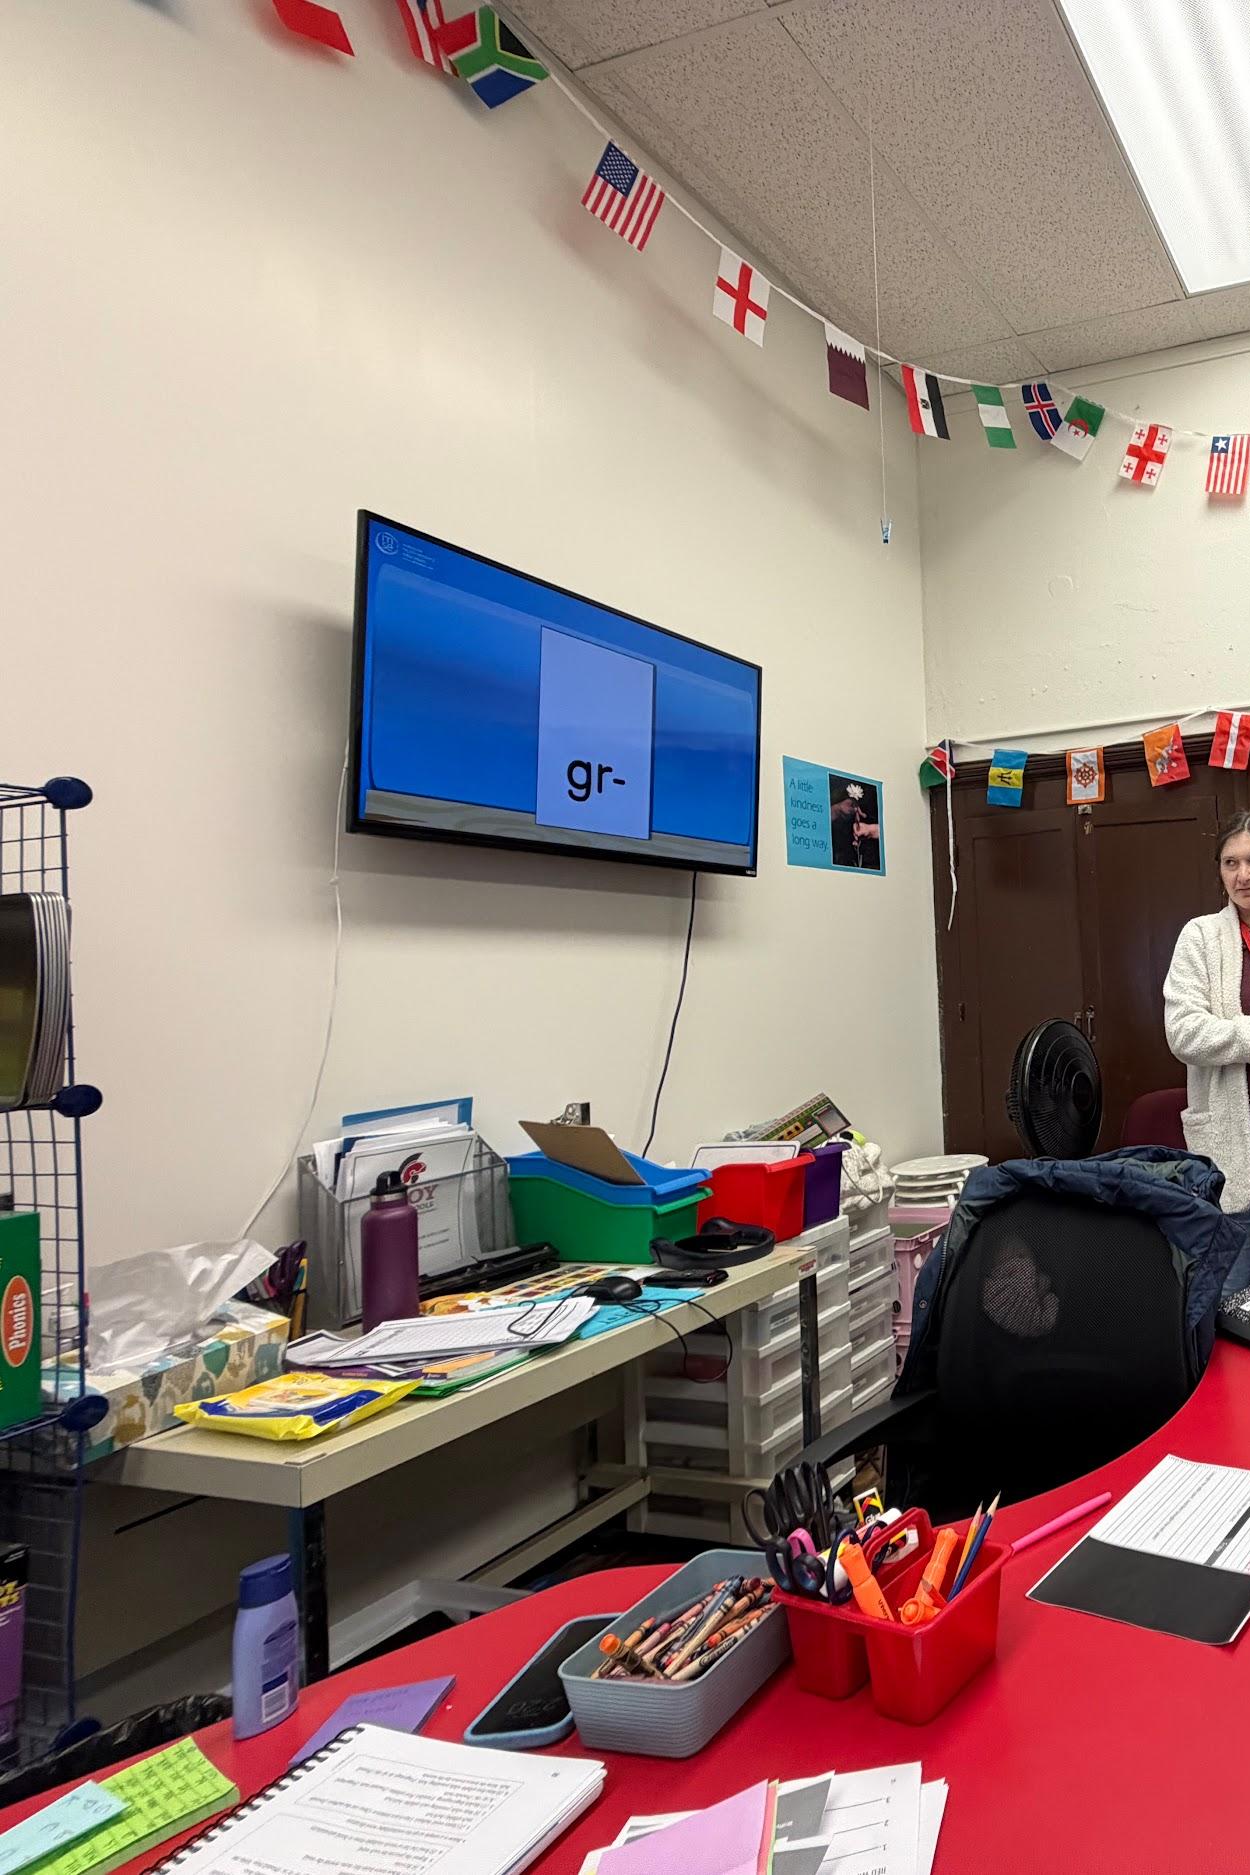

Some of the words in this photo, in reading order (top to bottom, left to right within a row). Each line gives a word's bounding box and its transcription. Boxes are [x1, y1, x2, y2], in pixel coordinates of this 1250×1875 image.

[566, 760, 626, 802] gr-
[789, 778, 797, 790] A
[797, 780, 815, 794] little
[790, 796, 824, 814] kindness
[791, 817, 811, 831] goes
[811, 821, 818, 831] a
[791, 833, 811, 850] long
[812, 838, 829, 853] way.
[409, 1184, 438, 1204] OY
[8, 1293, 27, 1351] Phonics
